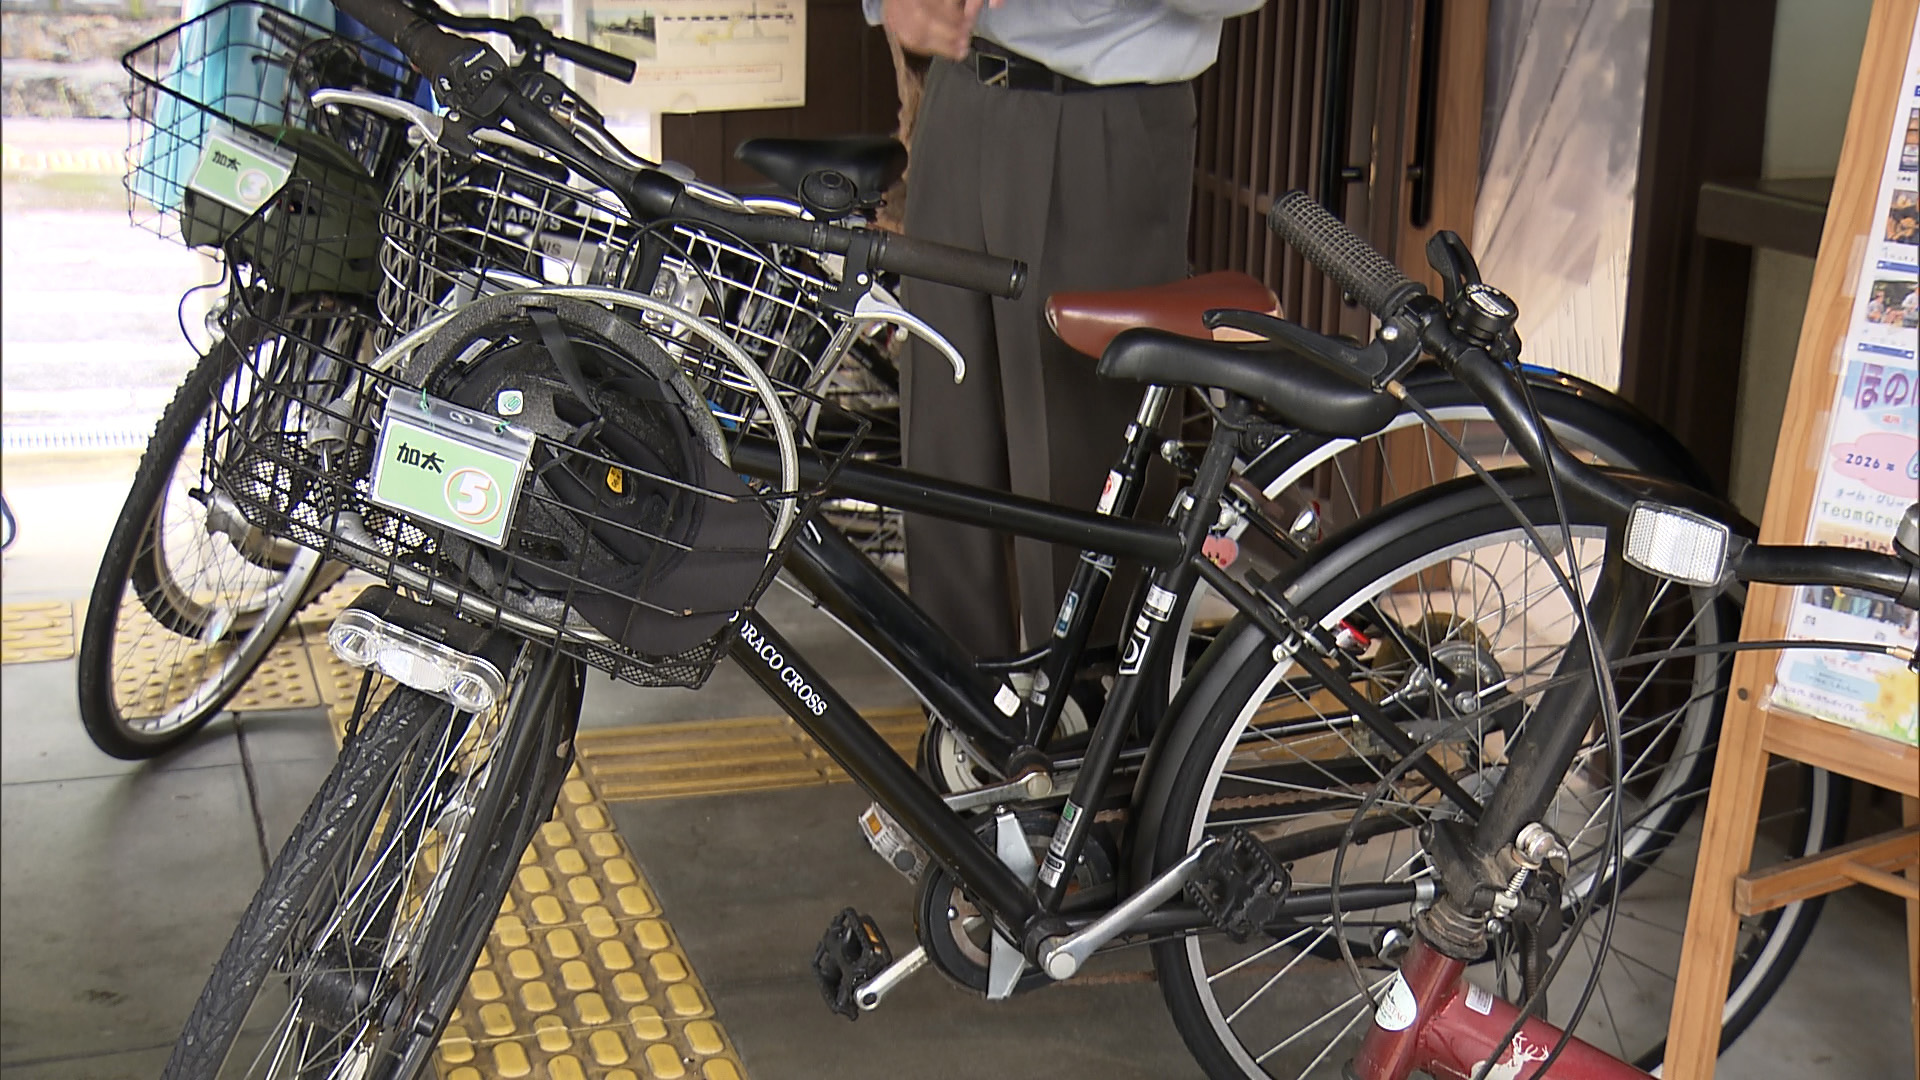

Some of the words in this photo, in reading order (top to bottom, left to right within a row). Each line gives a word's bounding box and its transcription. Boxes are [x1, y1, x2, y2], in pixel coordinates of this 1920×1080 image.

[212, 150, 241, 172] 加太
[242, 172, 268, 202] 3
[397, 441, 445, 475] 加太
[455, 471, 493, 517] 5
[780, 666, 828, 716] CROSS
